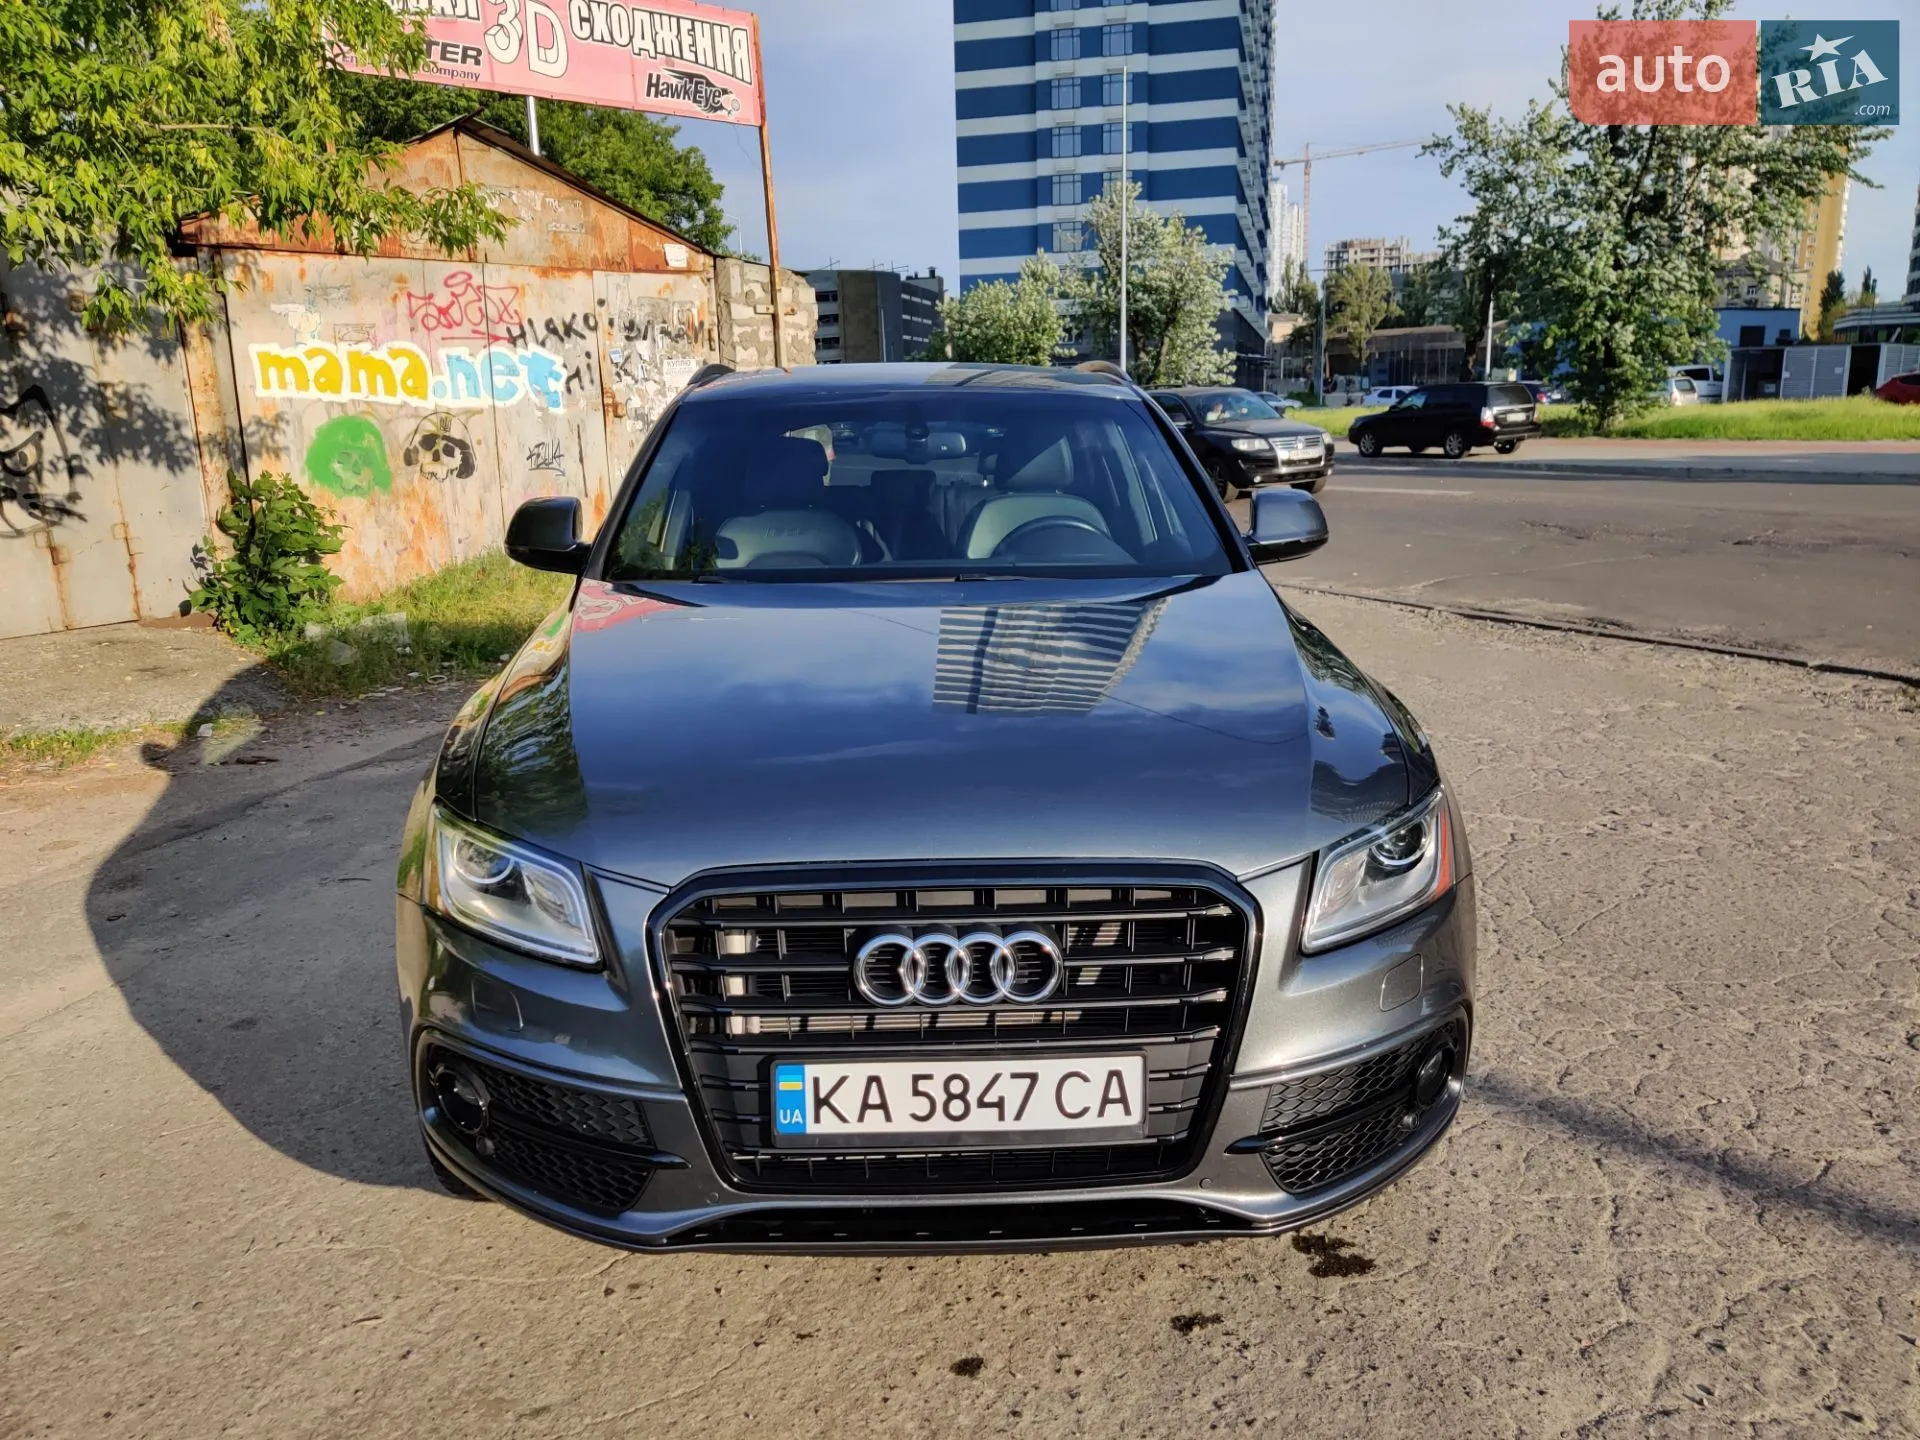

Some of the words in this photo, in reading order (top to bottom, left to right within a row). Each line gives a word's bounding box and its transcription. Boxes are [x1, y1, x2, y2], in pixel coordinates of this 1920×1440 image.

[484, 0, 568, 78] 3D
[569, 0, 752, 85] СХОДЖЕННЯ
[646, 73, 722, 113] HawkEye
[254, 345, 563, 410] mama.net
[779, 1108, 804, 1125] UA
[812, 1074, 894, 1125] KA
[908, 1071, 1040, 1123] 5847
[1054, 1068, 1133, 1120] CA
